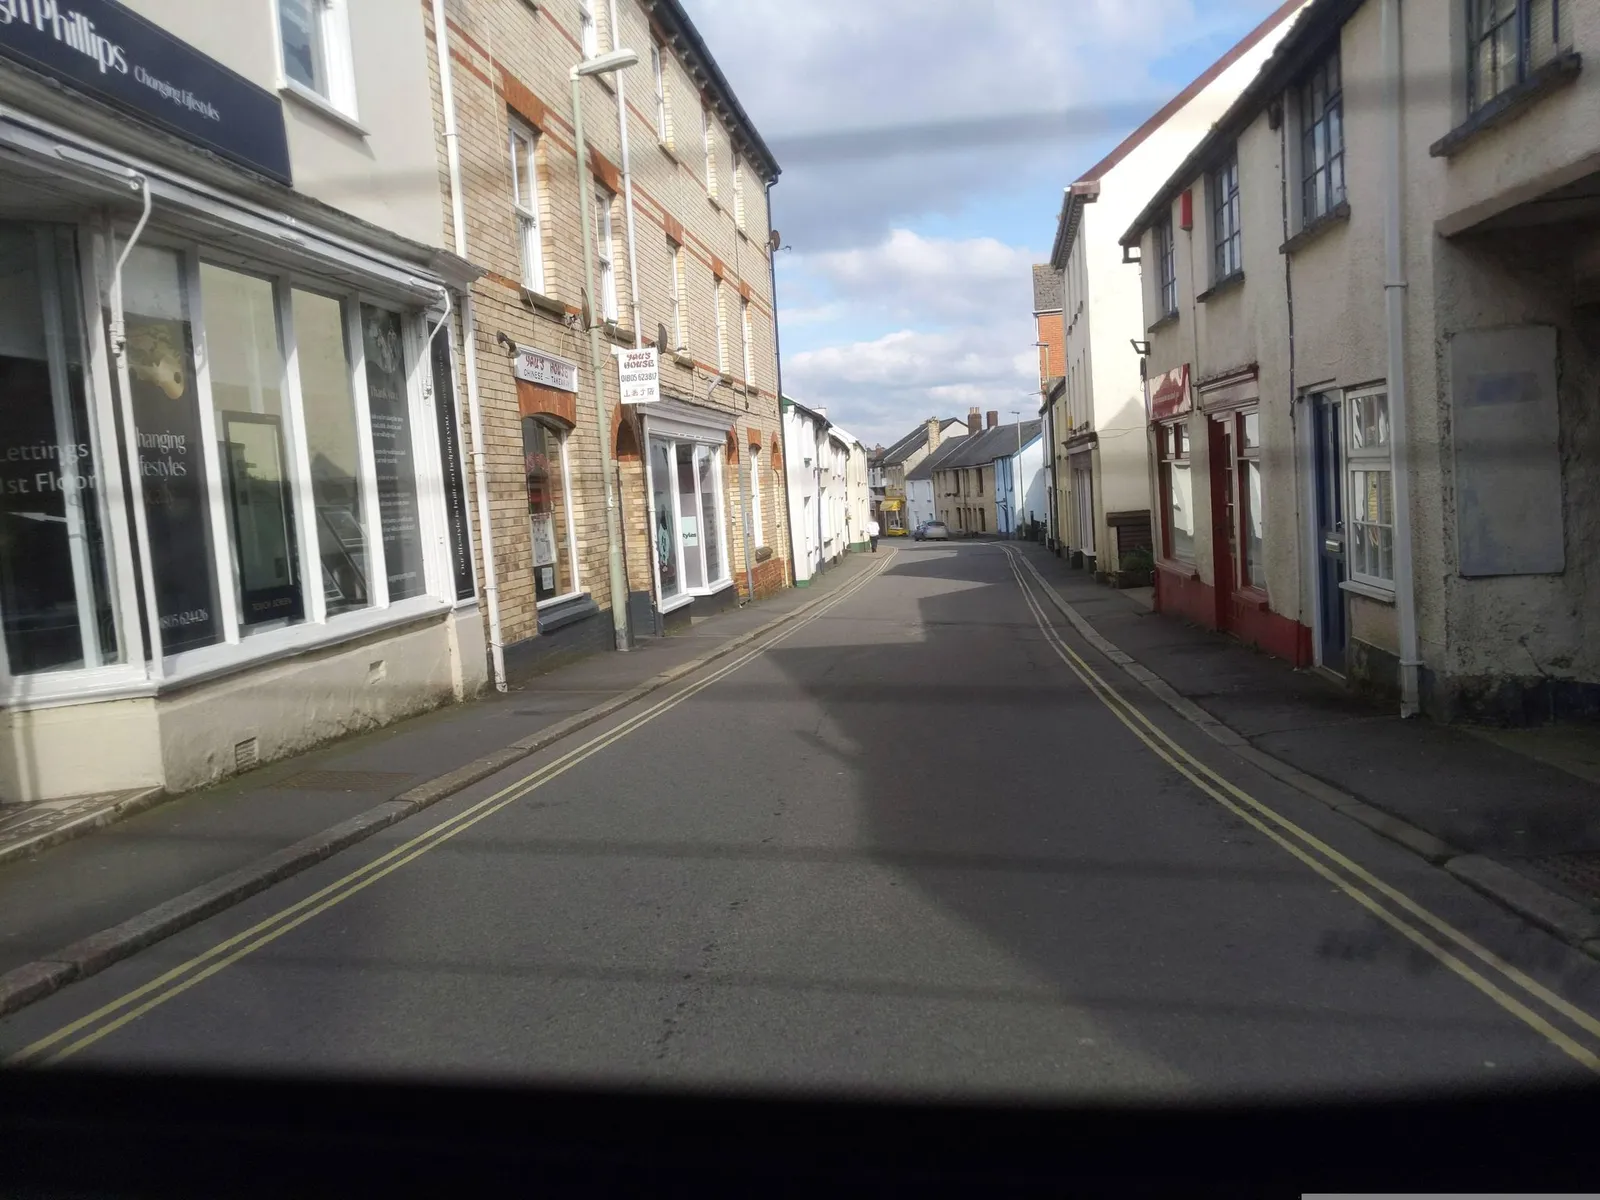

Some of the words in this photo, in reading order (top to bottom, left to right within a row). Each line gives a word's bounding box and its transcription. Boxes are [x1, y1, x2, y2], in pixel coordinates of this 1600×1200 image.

[33, 0, 128, 73] Phillips
[134, 65, 182, 106] Changing
[135, 426, 187, 454] hanging
[139, 455, 187, 481] festyles
